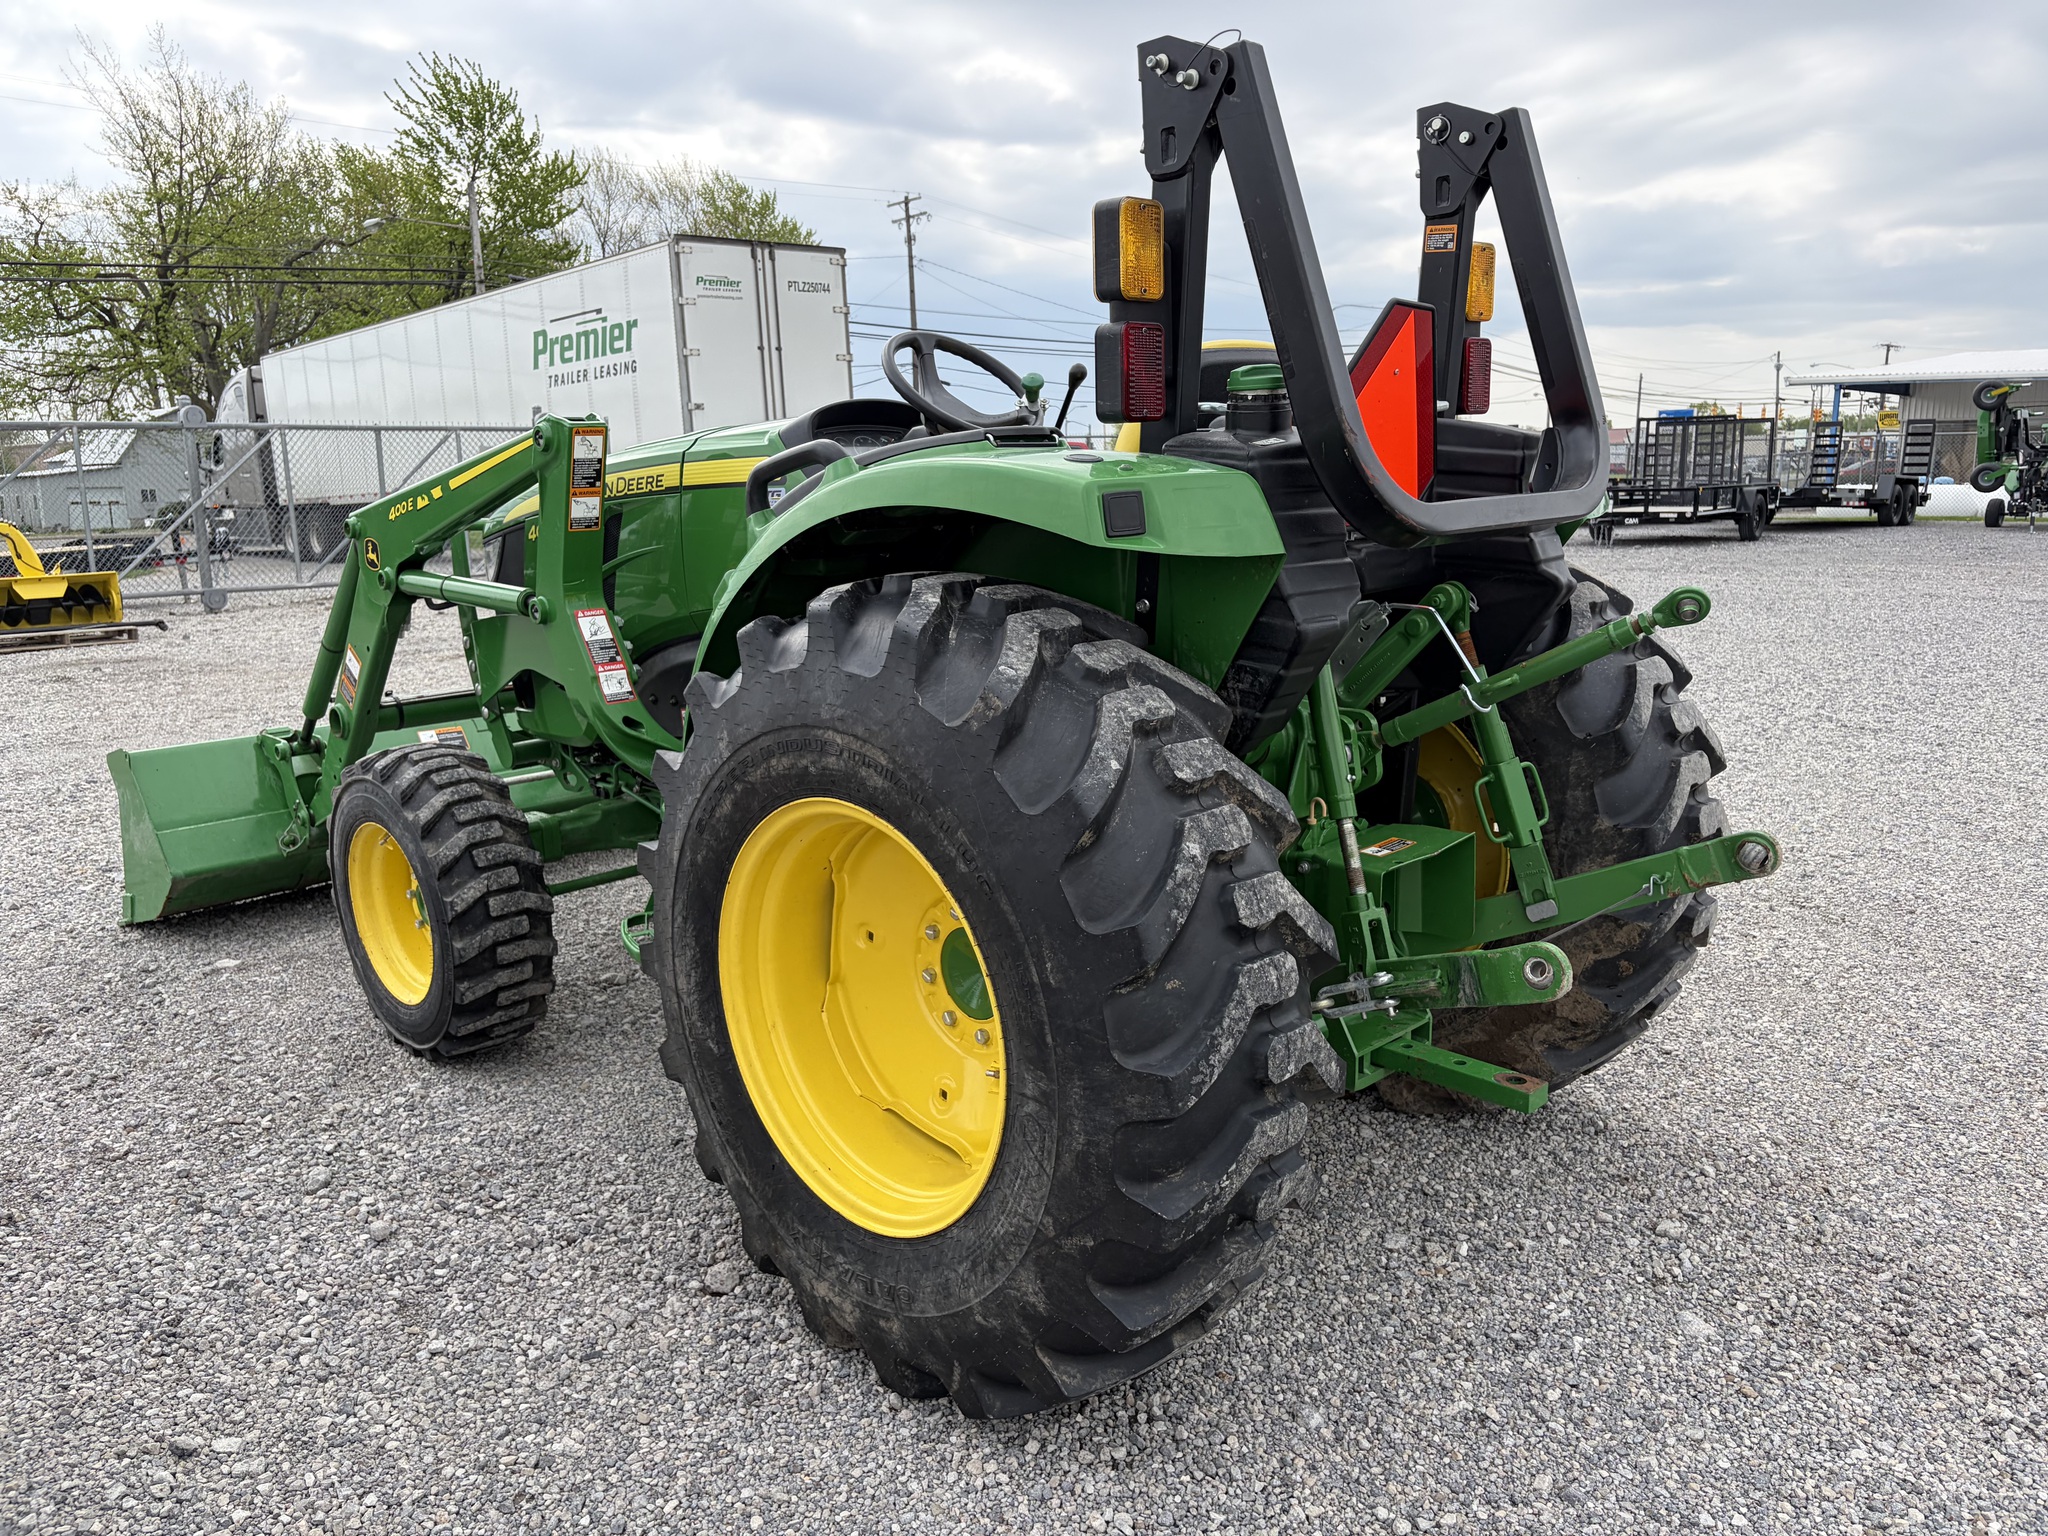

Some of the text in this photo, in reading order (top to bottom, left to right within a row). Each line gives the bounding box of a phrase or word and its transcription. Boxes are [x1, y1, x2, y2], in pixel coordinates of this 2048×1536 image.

[696, 276, 742, 288] Premier
[787, 280, 831, 294] PTLZ250744
[533, 317, 638, 371] Premier
[548, 359, 638, 388] TRAILER LEASING
[616, 473, 665, 494] DEERE
[1624, 517, 1639, 525] CAM
[584, 609, 605, 617] DANGER
[604, 663, 625, 671] DANGER
